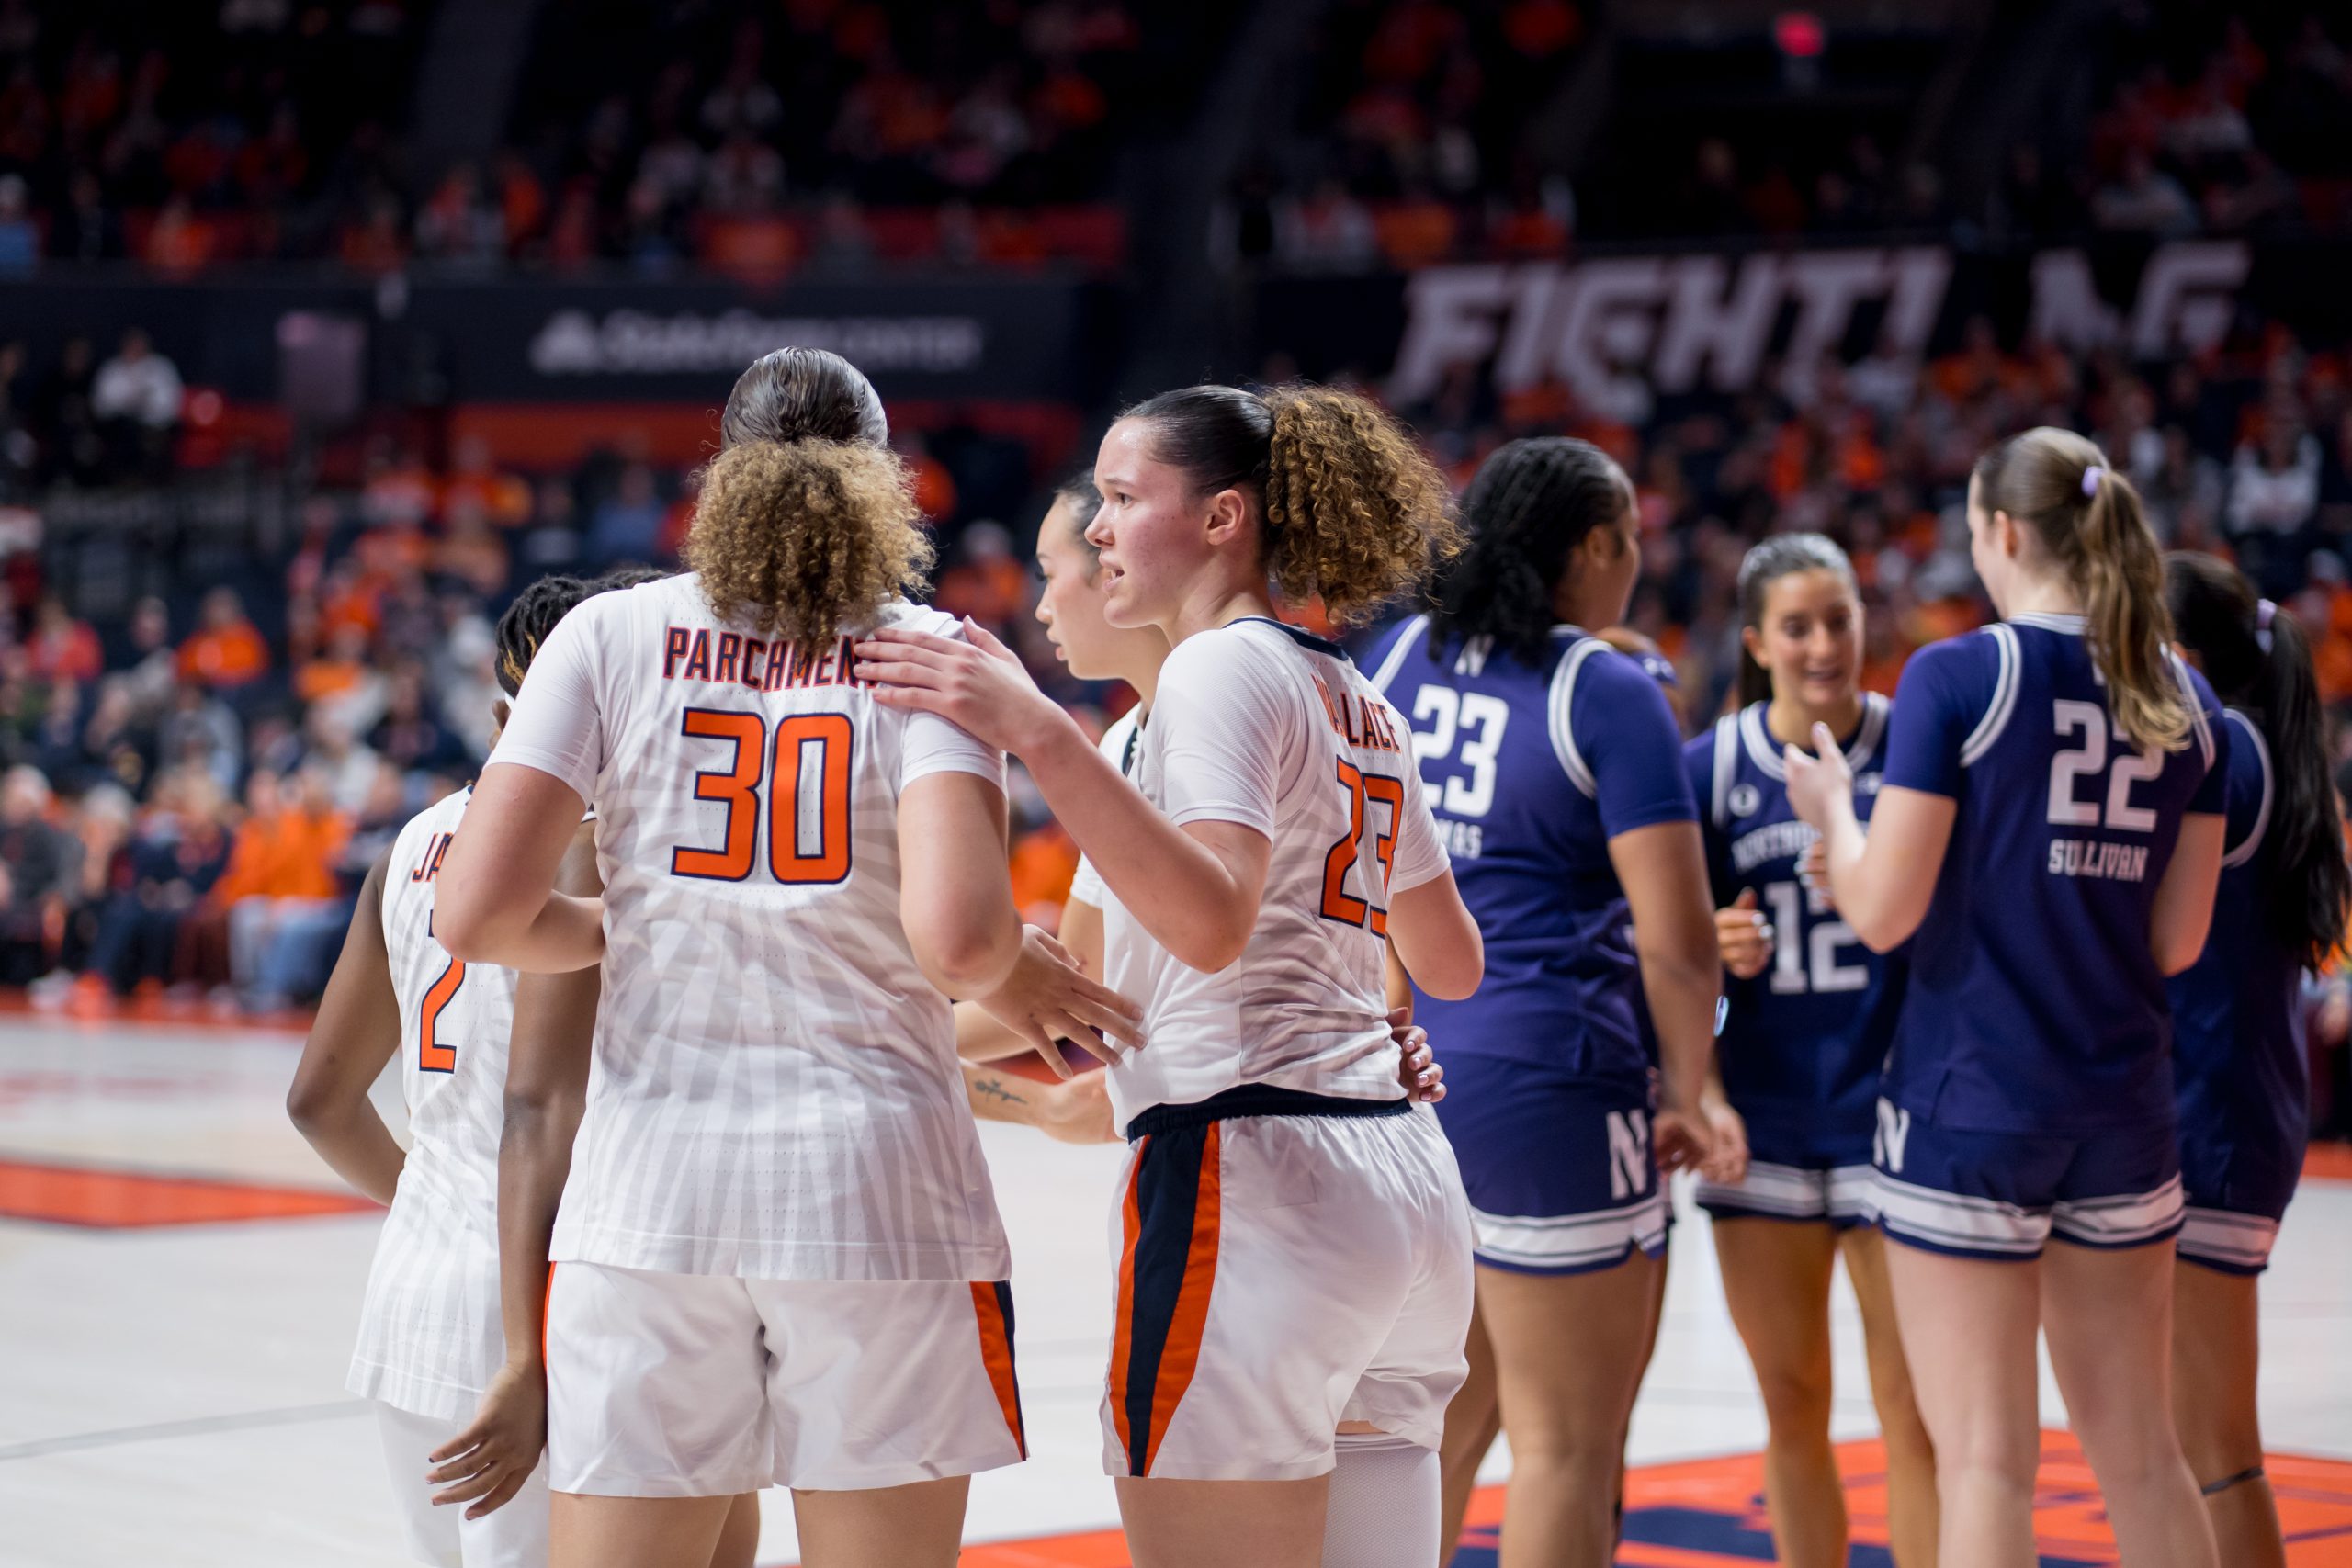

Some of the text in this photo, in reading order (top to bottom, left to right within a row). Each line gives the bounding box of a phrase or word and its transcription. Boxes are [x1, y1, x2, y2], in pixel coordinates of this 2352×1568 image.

[662, 626, 879, 693] PARCHMEN
[671, 706, 854, 885] 30
[1412, 683, 1510, 818] 23
[2047, 698, 2164, 832] 22
[1319, 755, 1404, 939] 23
[2048, 838, 2149, 883] SULLIVAN
[1764, 880, 1870, 995] 12
[1606, 1108, 1649, 1201] N
[1873, 1097, 1910, 1173] N
